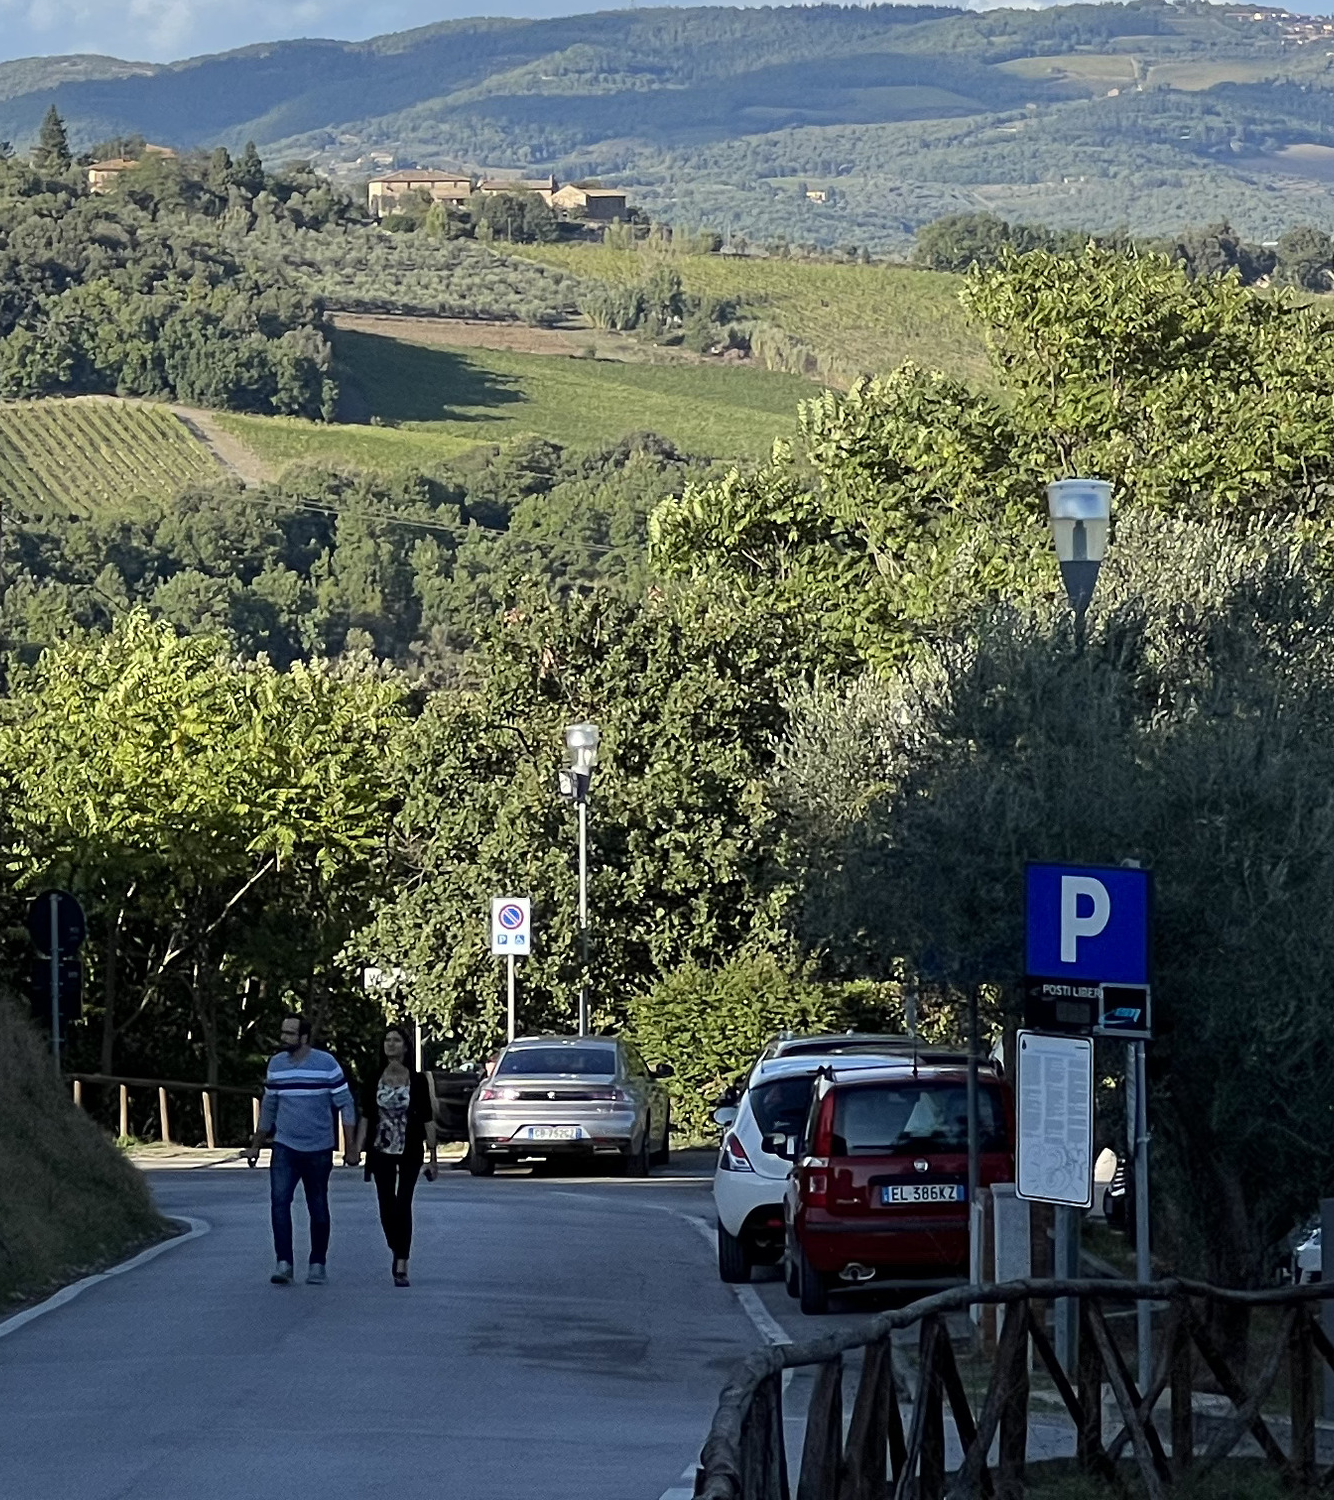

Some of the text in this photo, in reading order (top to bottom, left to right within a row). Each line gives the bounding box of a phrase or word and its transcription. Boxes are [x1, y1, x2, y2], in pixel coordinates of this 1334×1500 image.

[1061, 875, 1110, 963] P
[1043, 984, 1071, 997] POSTI
[891, 1185, 956, 1201] EL 386KZ
